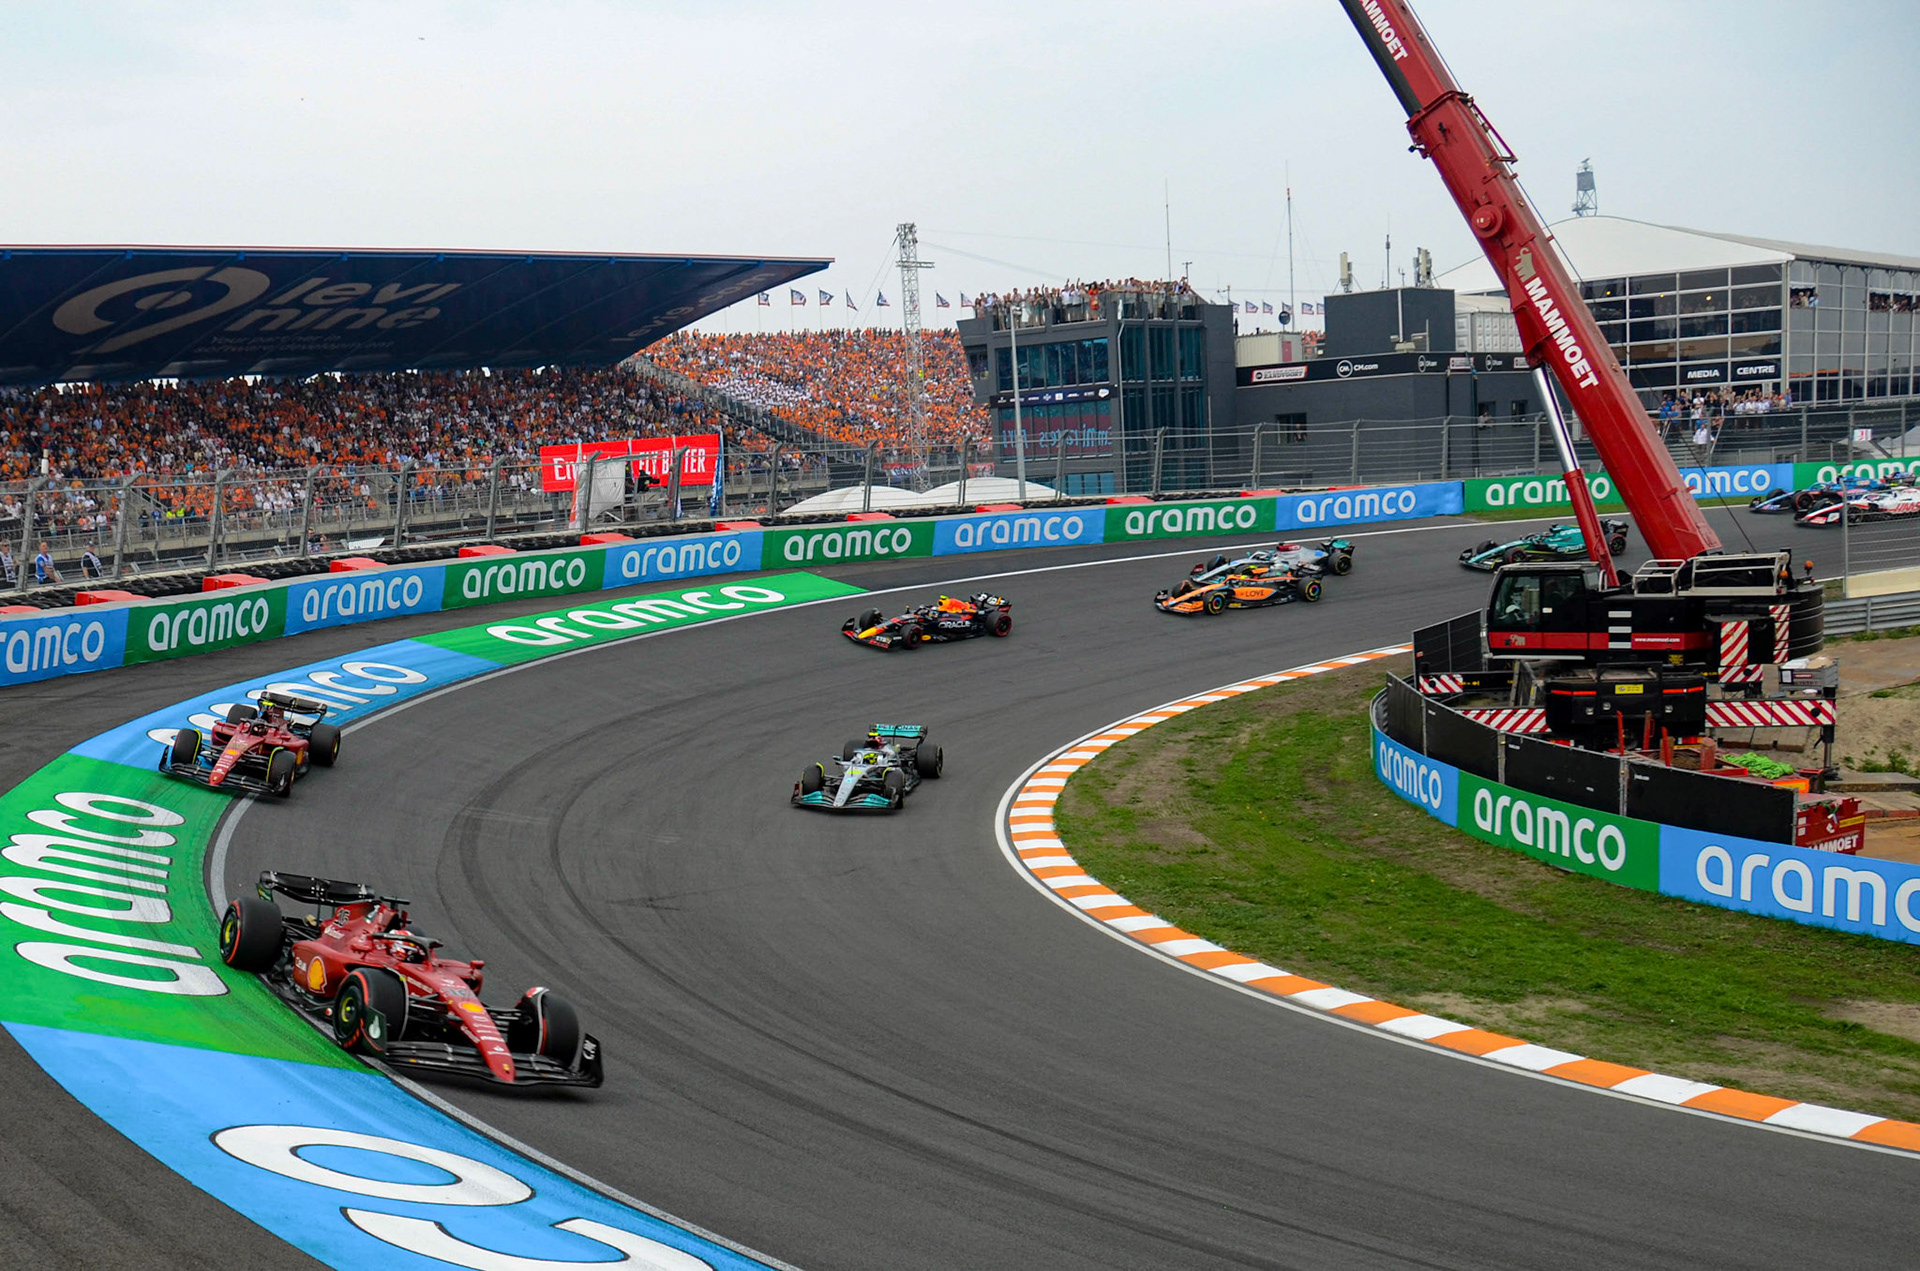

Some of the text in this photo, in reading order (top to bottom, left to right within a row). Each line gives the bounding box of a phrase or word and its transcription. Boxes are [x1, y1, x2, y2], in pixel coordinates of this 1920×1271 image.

[267, 277, 462, 305] levi
[224, 307, 441, 331] nine
[1525, 277, 1599, 389] MAMMOET
[1687, 365, 1775, 379] MEDIA CENTRE
[639, 451, 658, 475] FLY
[661, 448, 706, 475] BTER
[1485, 477, 1610, 506] aramo
[1680, 469, 1771, 493] amco
[1125, 504, 1257, 536] aramco
[1297, 490, 1416, 523] aramco
[783, 527, 912, 561] aramco
[954, 516, 1083, 547] aramco
[622, 539, 742, 578] aramco
[462, 557, 586, 599] aramco
[302, 574, 423, 622] aramco
[148, 597, 269, 651] aramco
[486, 585, 786, 646] aramco
[938, 620, 971, 628] ORACLE
[0, 621, 104, 674] amco
[1379, 741, 1443, 809] aramco
[1474, 788, 1626, 872] aramco
[1808, 834, 1859, 853] AMMOET
[0, 792, 231, 996] aramco
